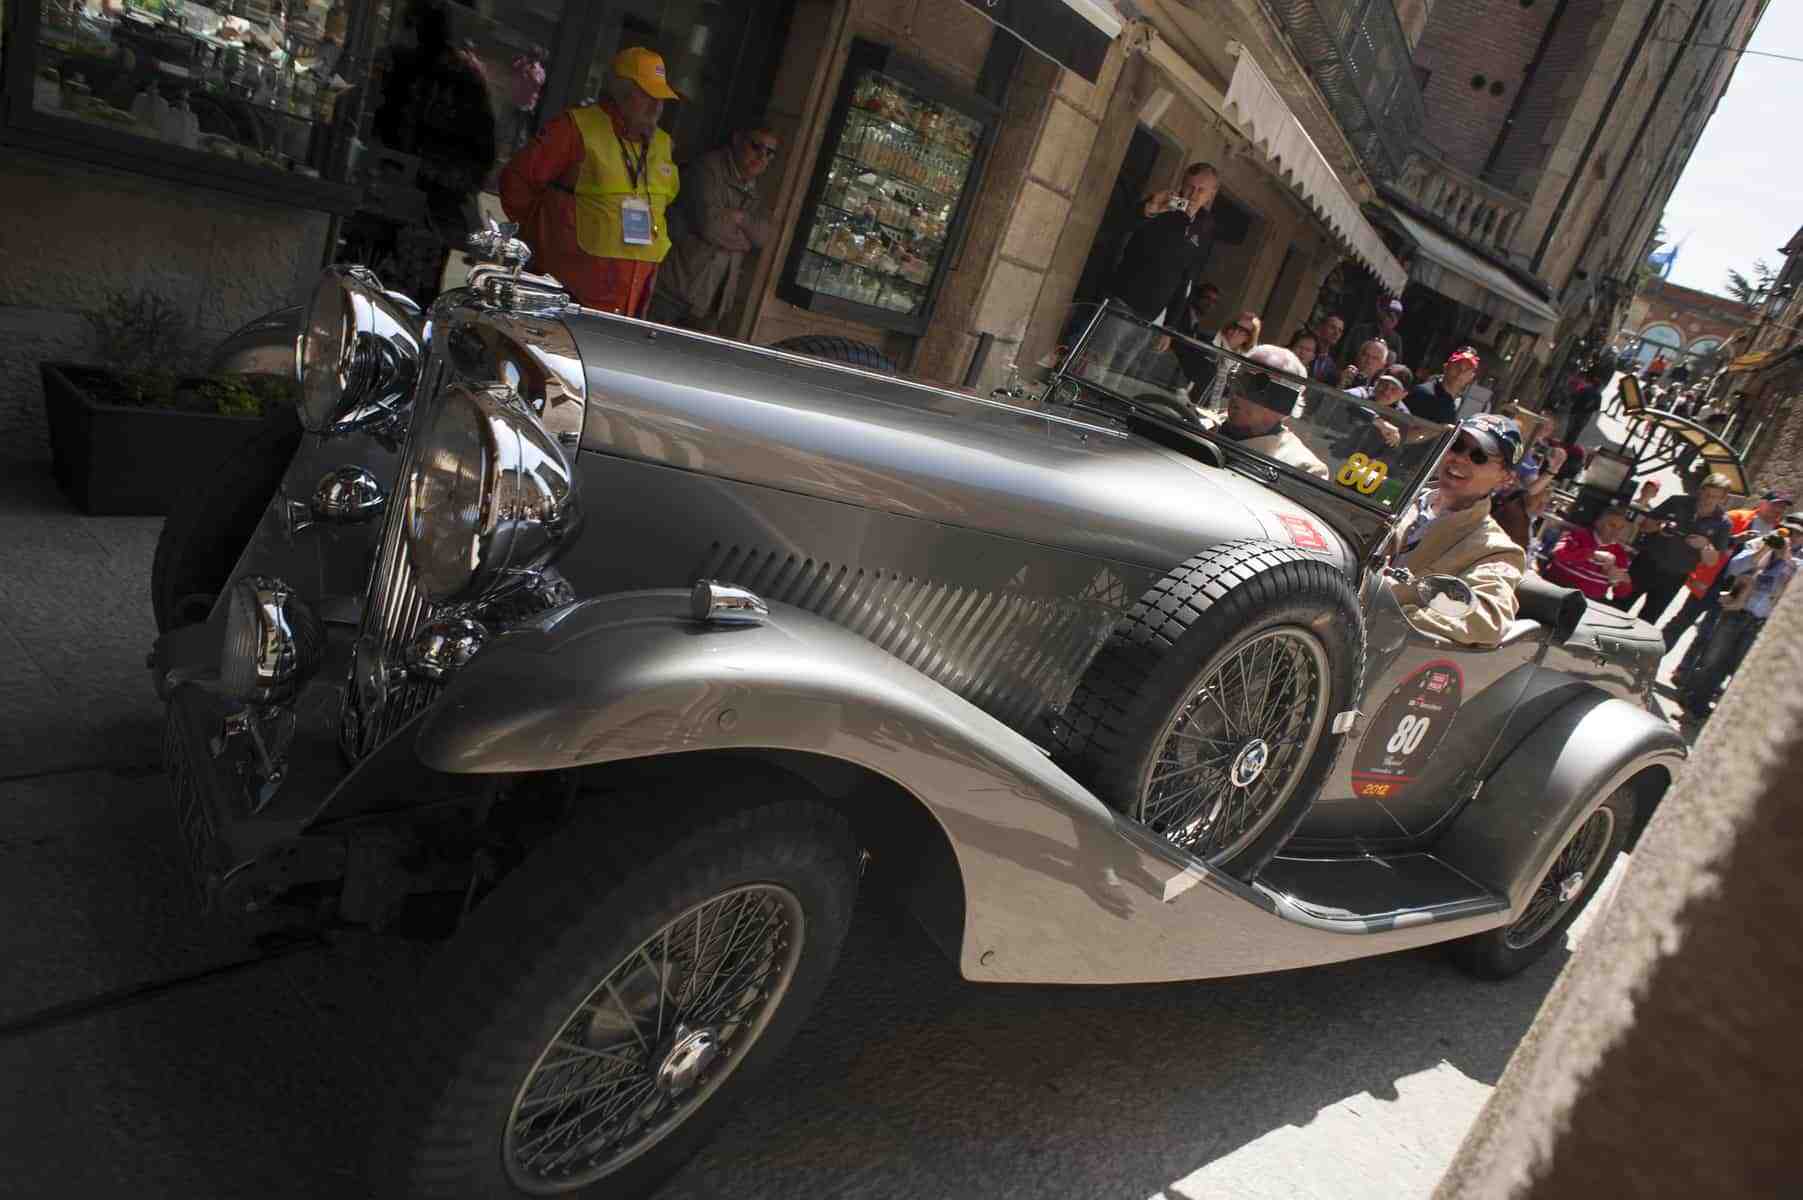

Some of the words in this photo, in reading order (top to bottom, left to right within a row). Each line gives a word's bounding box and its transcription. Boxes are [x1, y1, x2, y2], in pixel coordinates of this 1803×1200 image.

[1336, 451, 1389, 495] 80
[1386, 714, 1431, 755] 80
[1361, 783, 1390, 796] 2012
